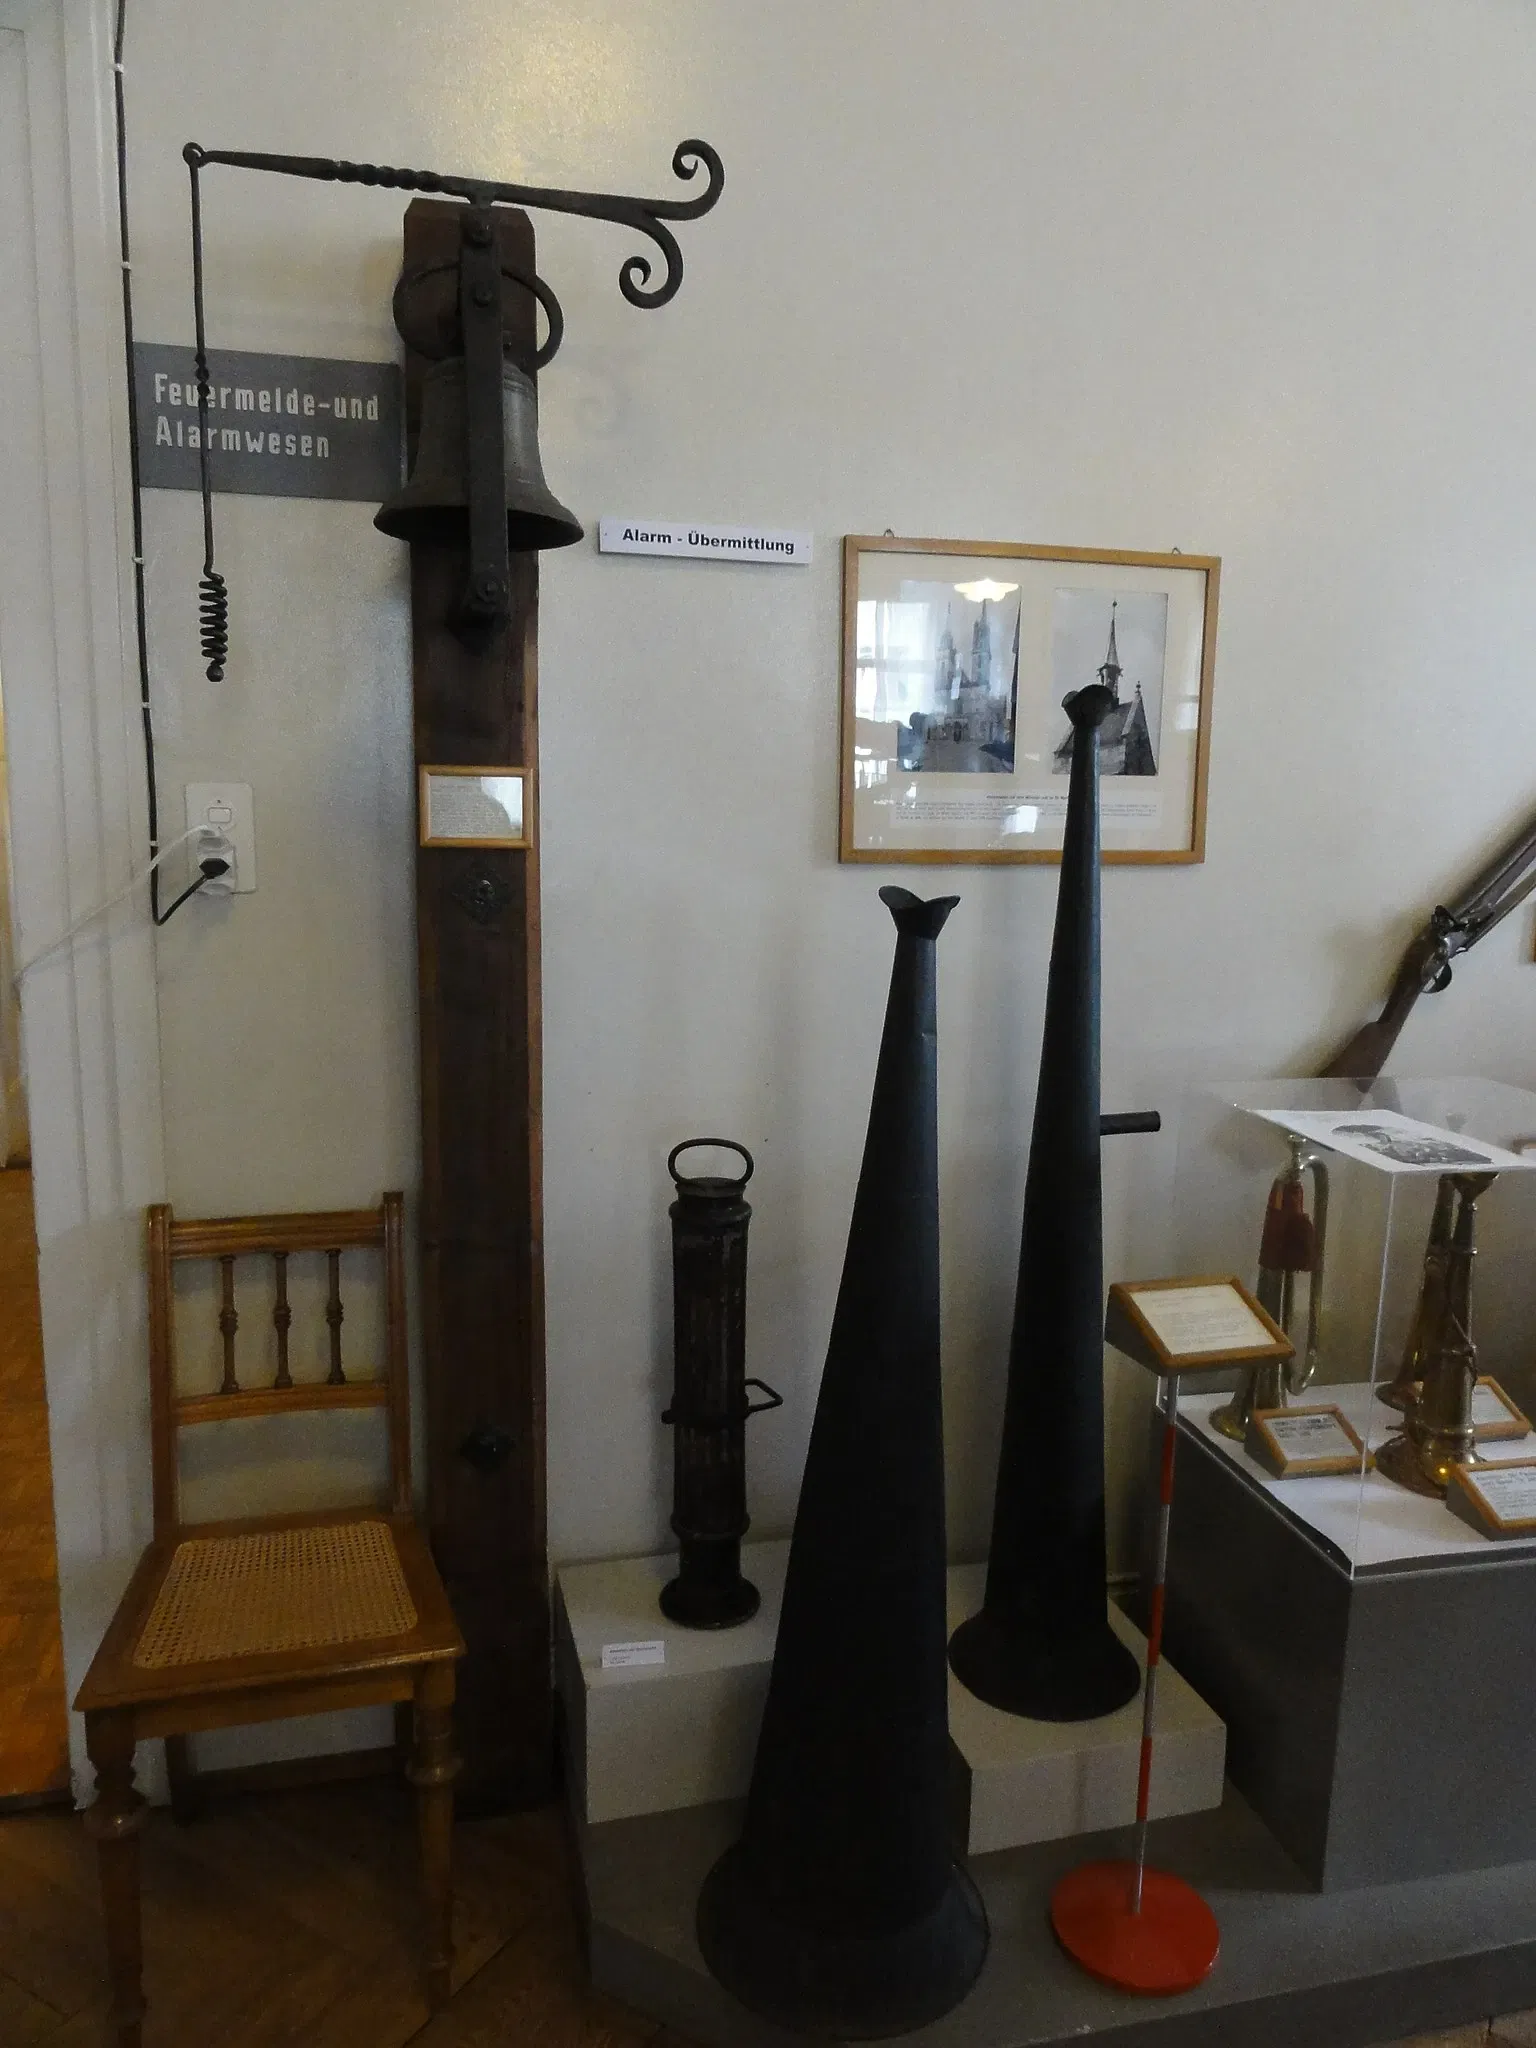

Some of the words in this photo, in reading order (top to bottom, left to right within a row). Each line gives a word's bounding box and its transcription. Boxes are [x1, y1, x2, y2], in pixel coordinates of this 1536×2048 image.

[156, 415, 330, 459] Alarmwesen
[622, 528, 672, 544] Alarm
[688, 530, 795, 555] Übermittlung
